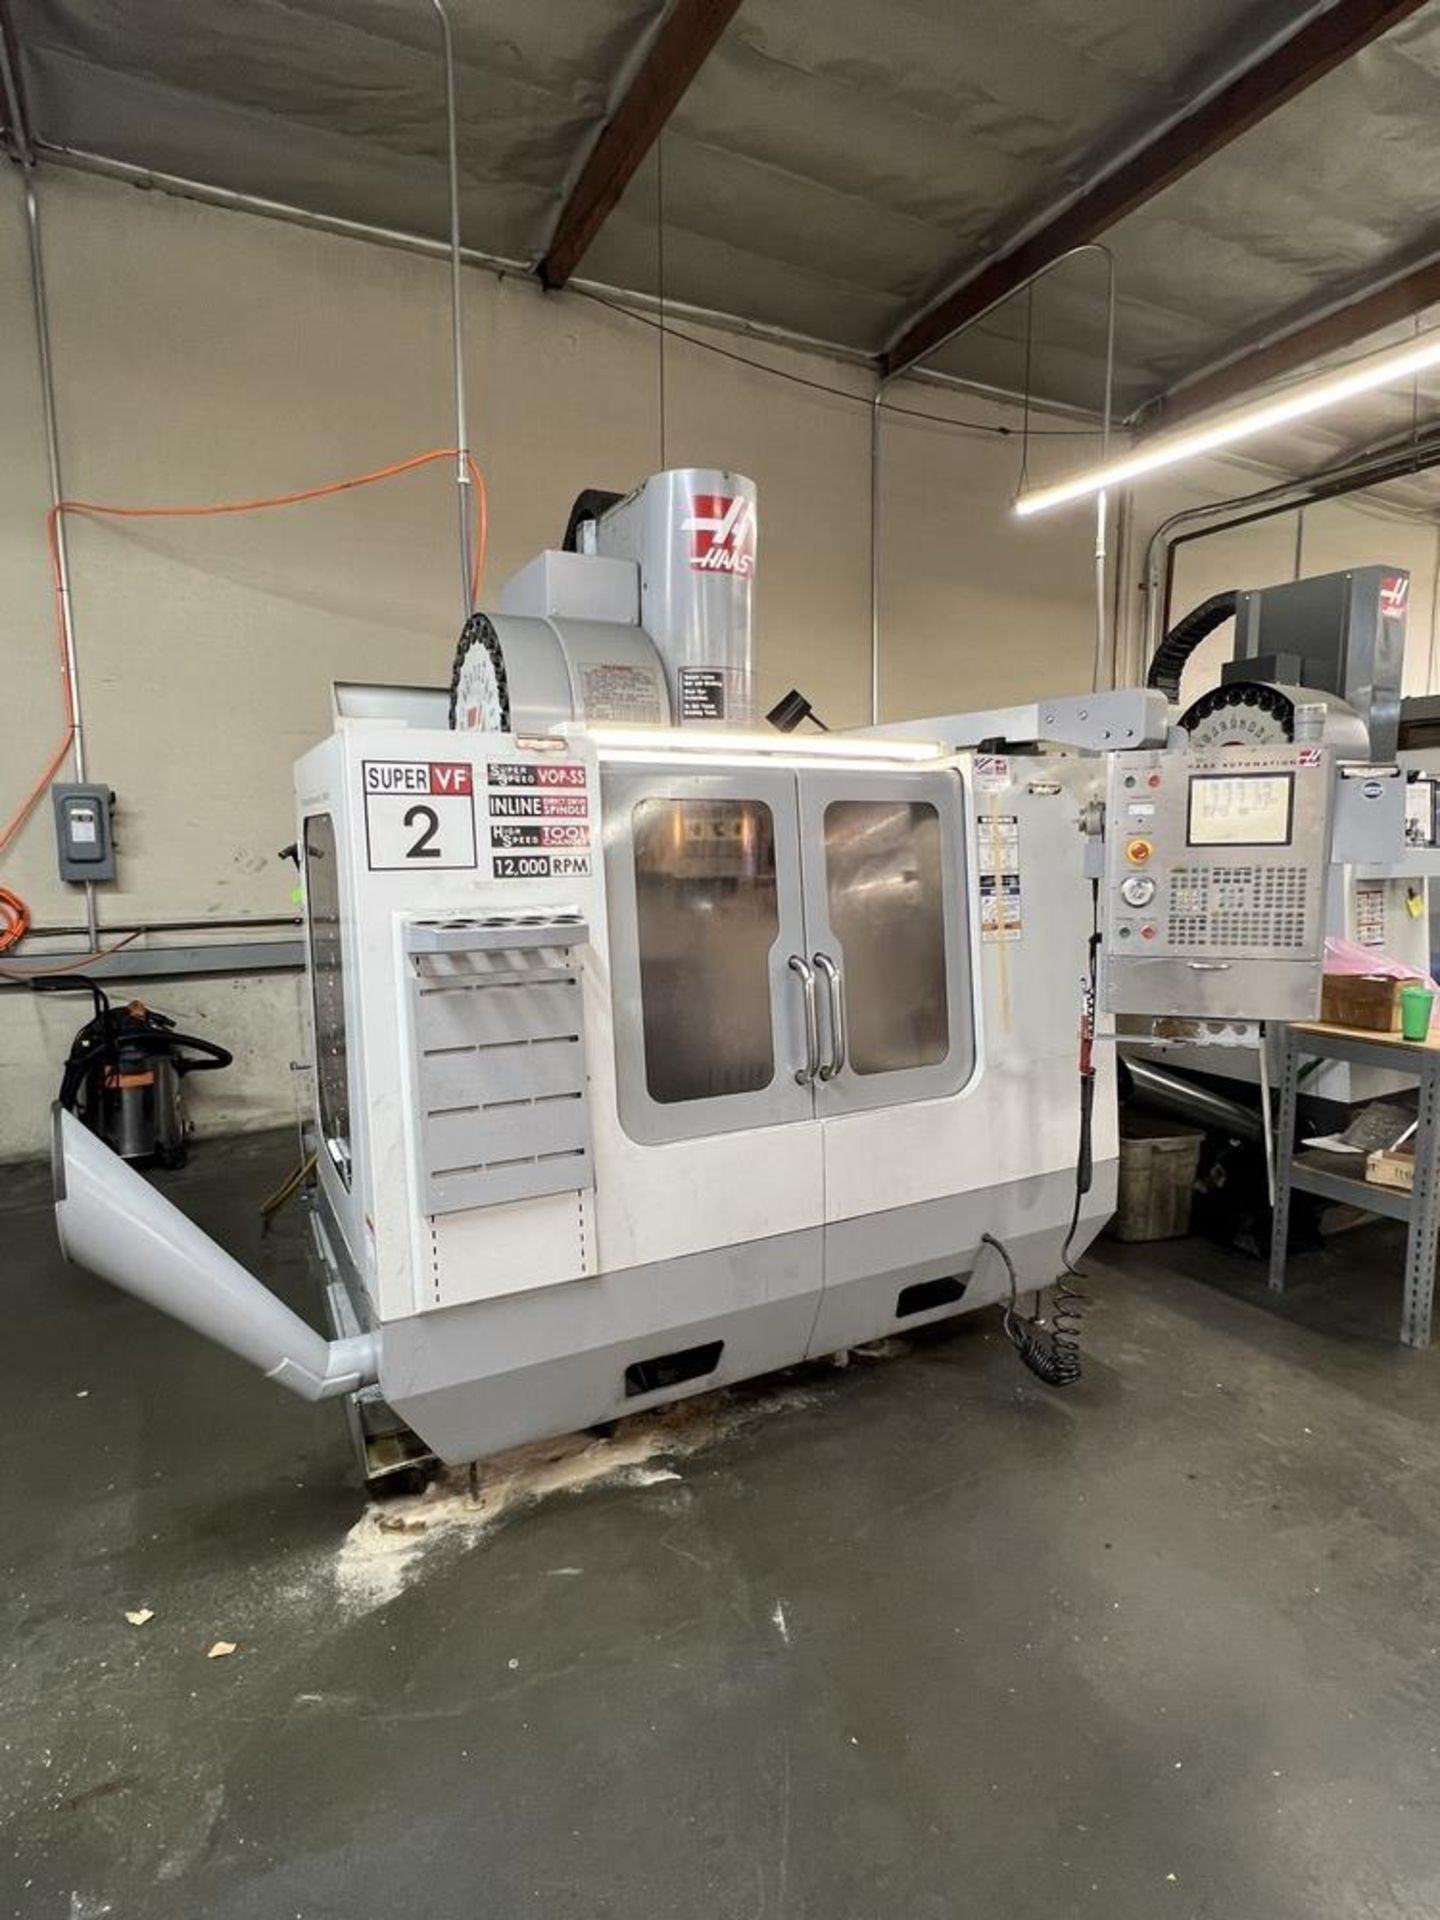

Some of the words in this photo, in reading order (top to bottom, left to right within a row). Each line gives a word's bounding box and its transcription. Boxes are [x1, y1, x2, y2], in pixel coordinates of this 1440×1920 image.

[368, 767, 427, 790] SUPER
[435, 768, 466, 791] VF
[490, 797, 542, 815] INLINE
[403, 804, 441, 858] 2
[495, 859, 548, 876] 12,000
[552, 859, 588, 874] RPM
